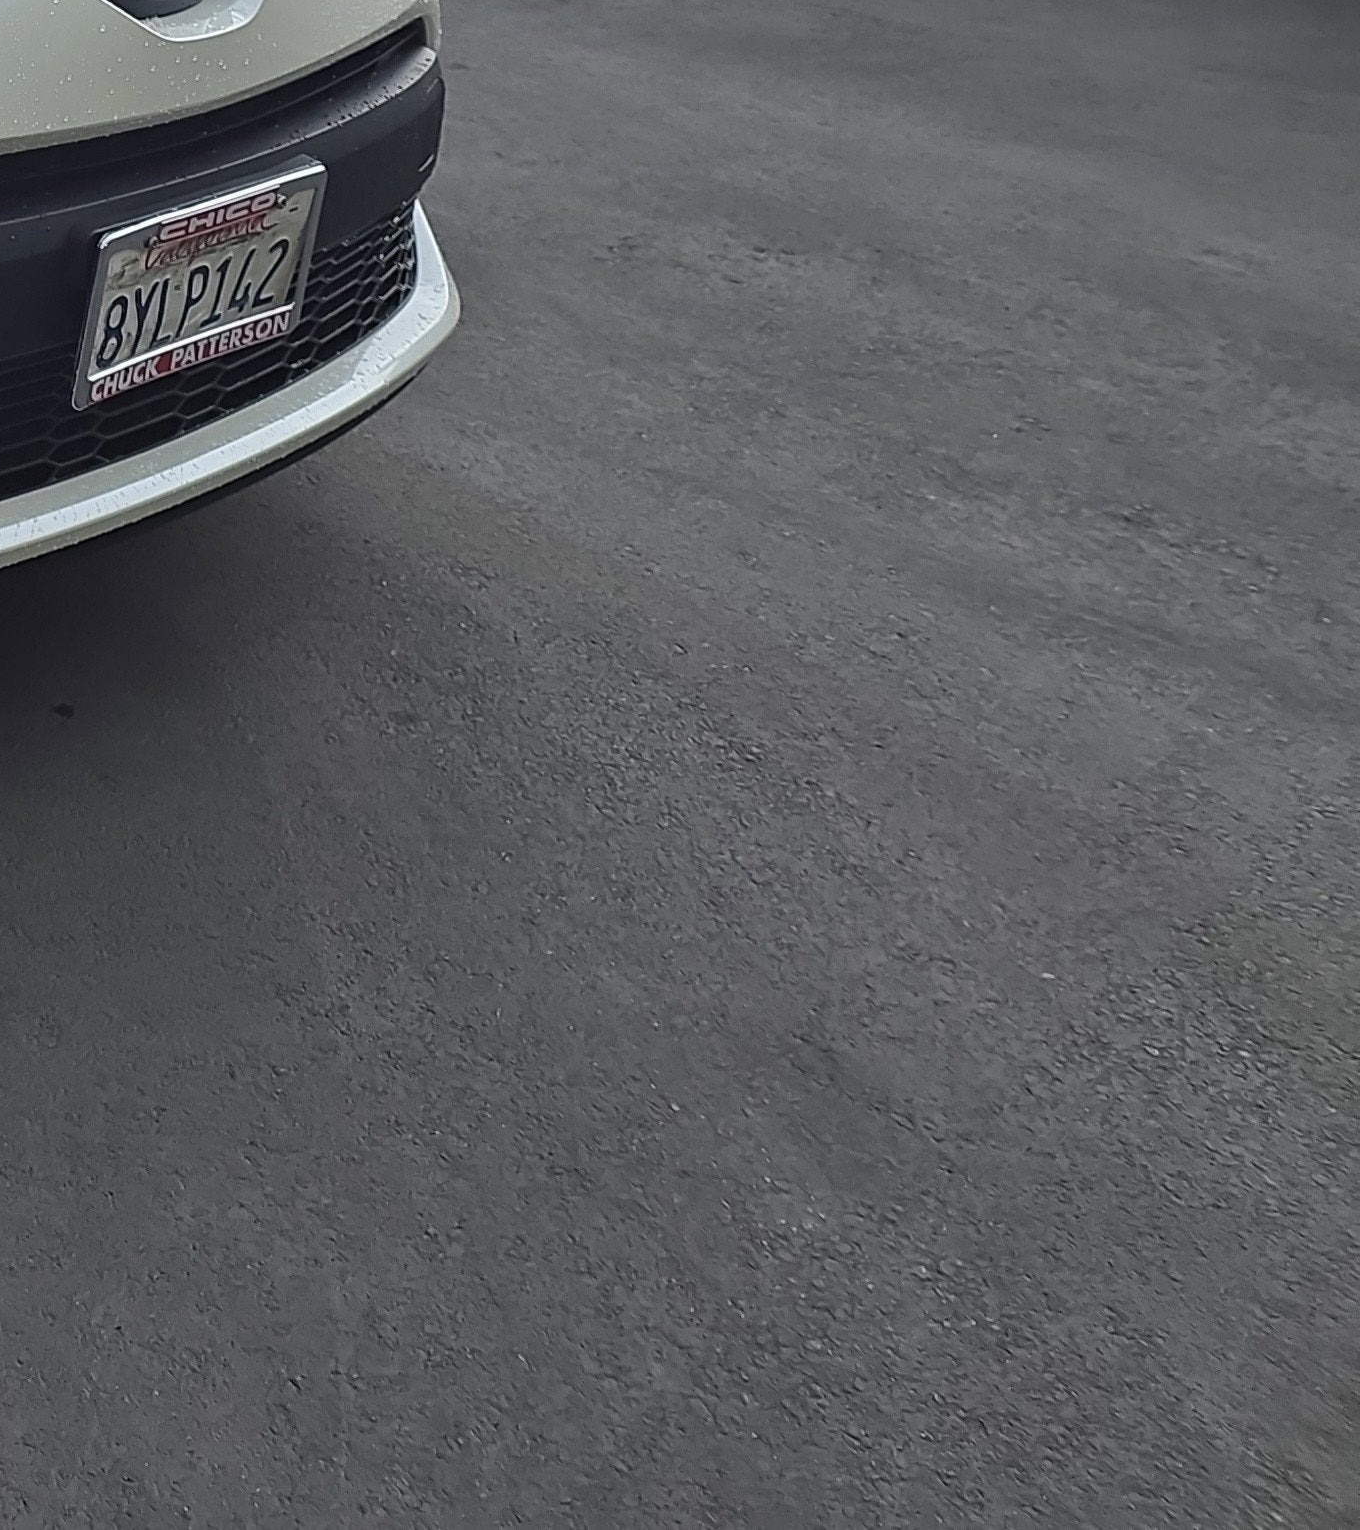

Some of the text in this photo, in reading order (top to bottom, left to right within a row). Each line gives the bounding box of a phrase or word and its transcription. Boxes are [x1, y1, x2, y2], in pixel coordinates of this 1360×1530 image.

[160, 192, 277, 240] CHICO
[96, 238, 290, 369] 8YLP142
[91, 311, 290, 402] CHUCK PATTERSON
